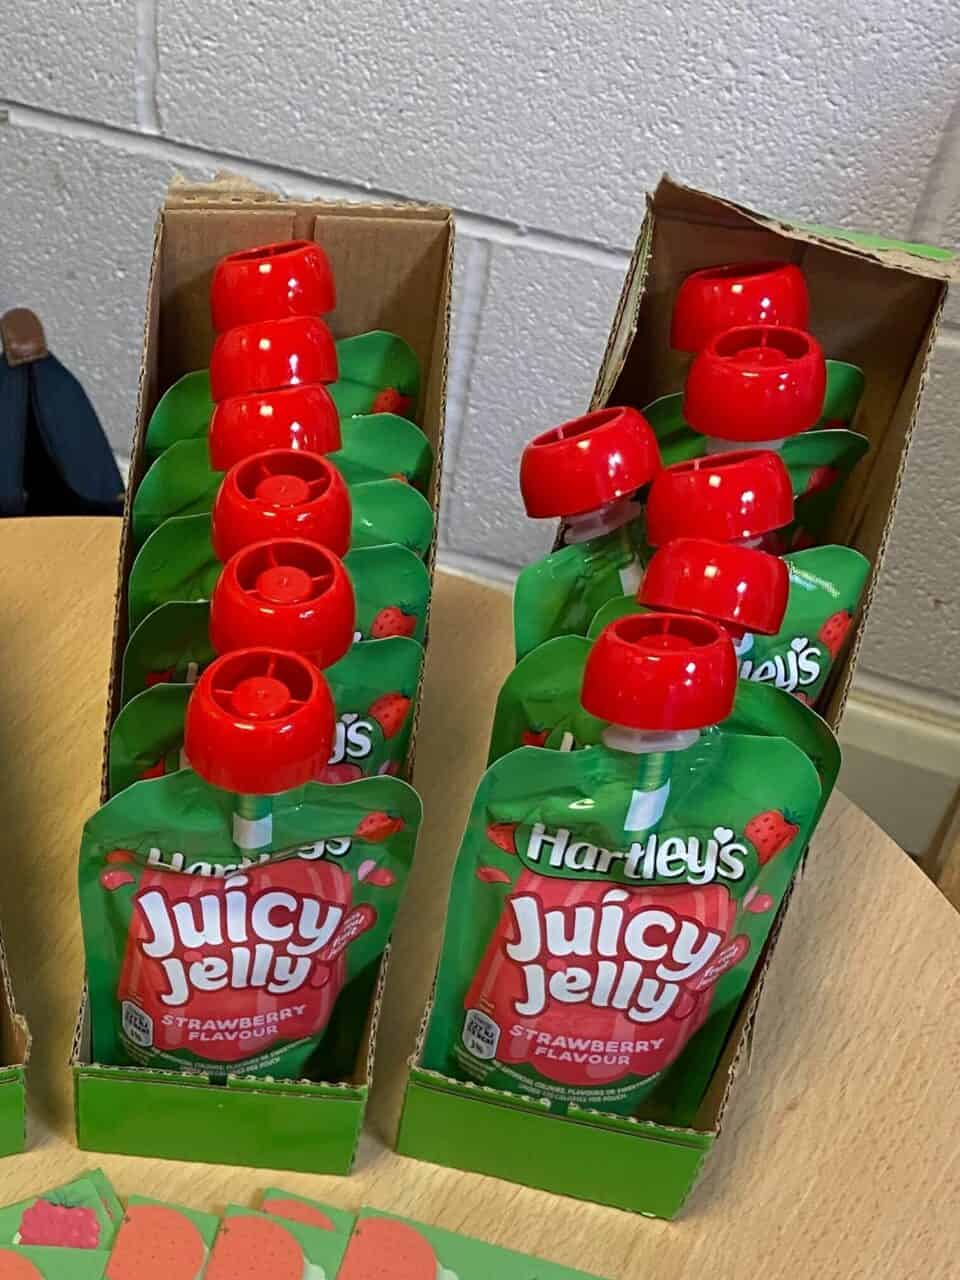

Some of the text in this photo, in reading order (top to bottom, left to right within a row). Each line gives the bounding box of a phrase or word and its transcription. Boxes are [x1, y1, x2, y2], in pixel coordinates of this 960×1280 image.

[526, 823, 748, 885] Hartley's
[138, 876, 342, 958] Juicy
[506, 889, 722, 982] Juicy
[161, 944, 312, 1006] Jelly
[515, 961, 680, 1023] Jelly
[161, 1003, 307, 1032] STRAWBERRY
[188, 1025, 279, 1042] FLAVOUR
[509, 1024, 665, 1054] STRAWBERRY
[535, 1045, 631, 1066] FLAVOUR
